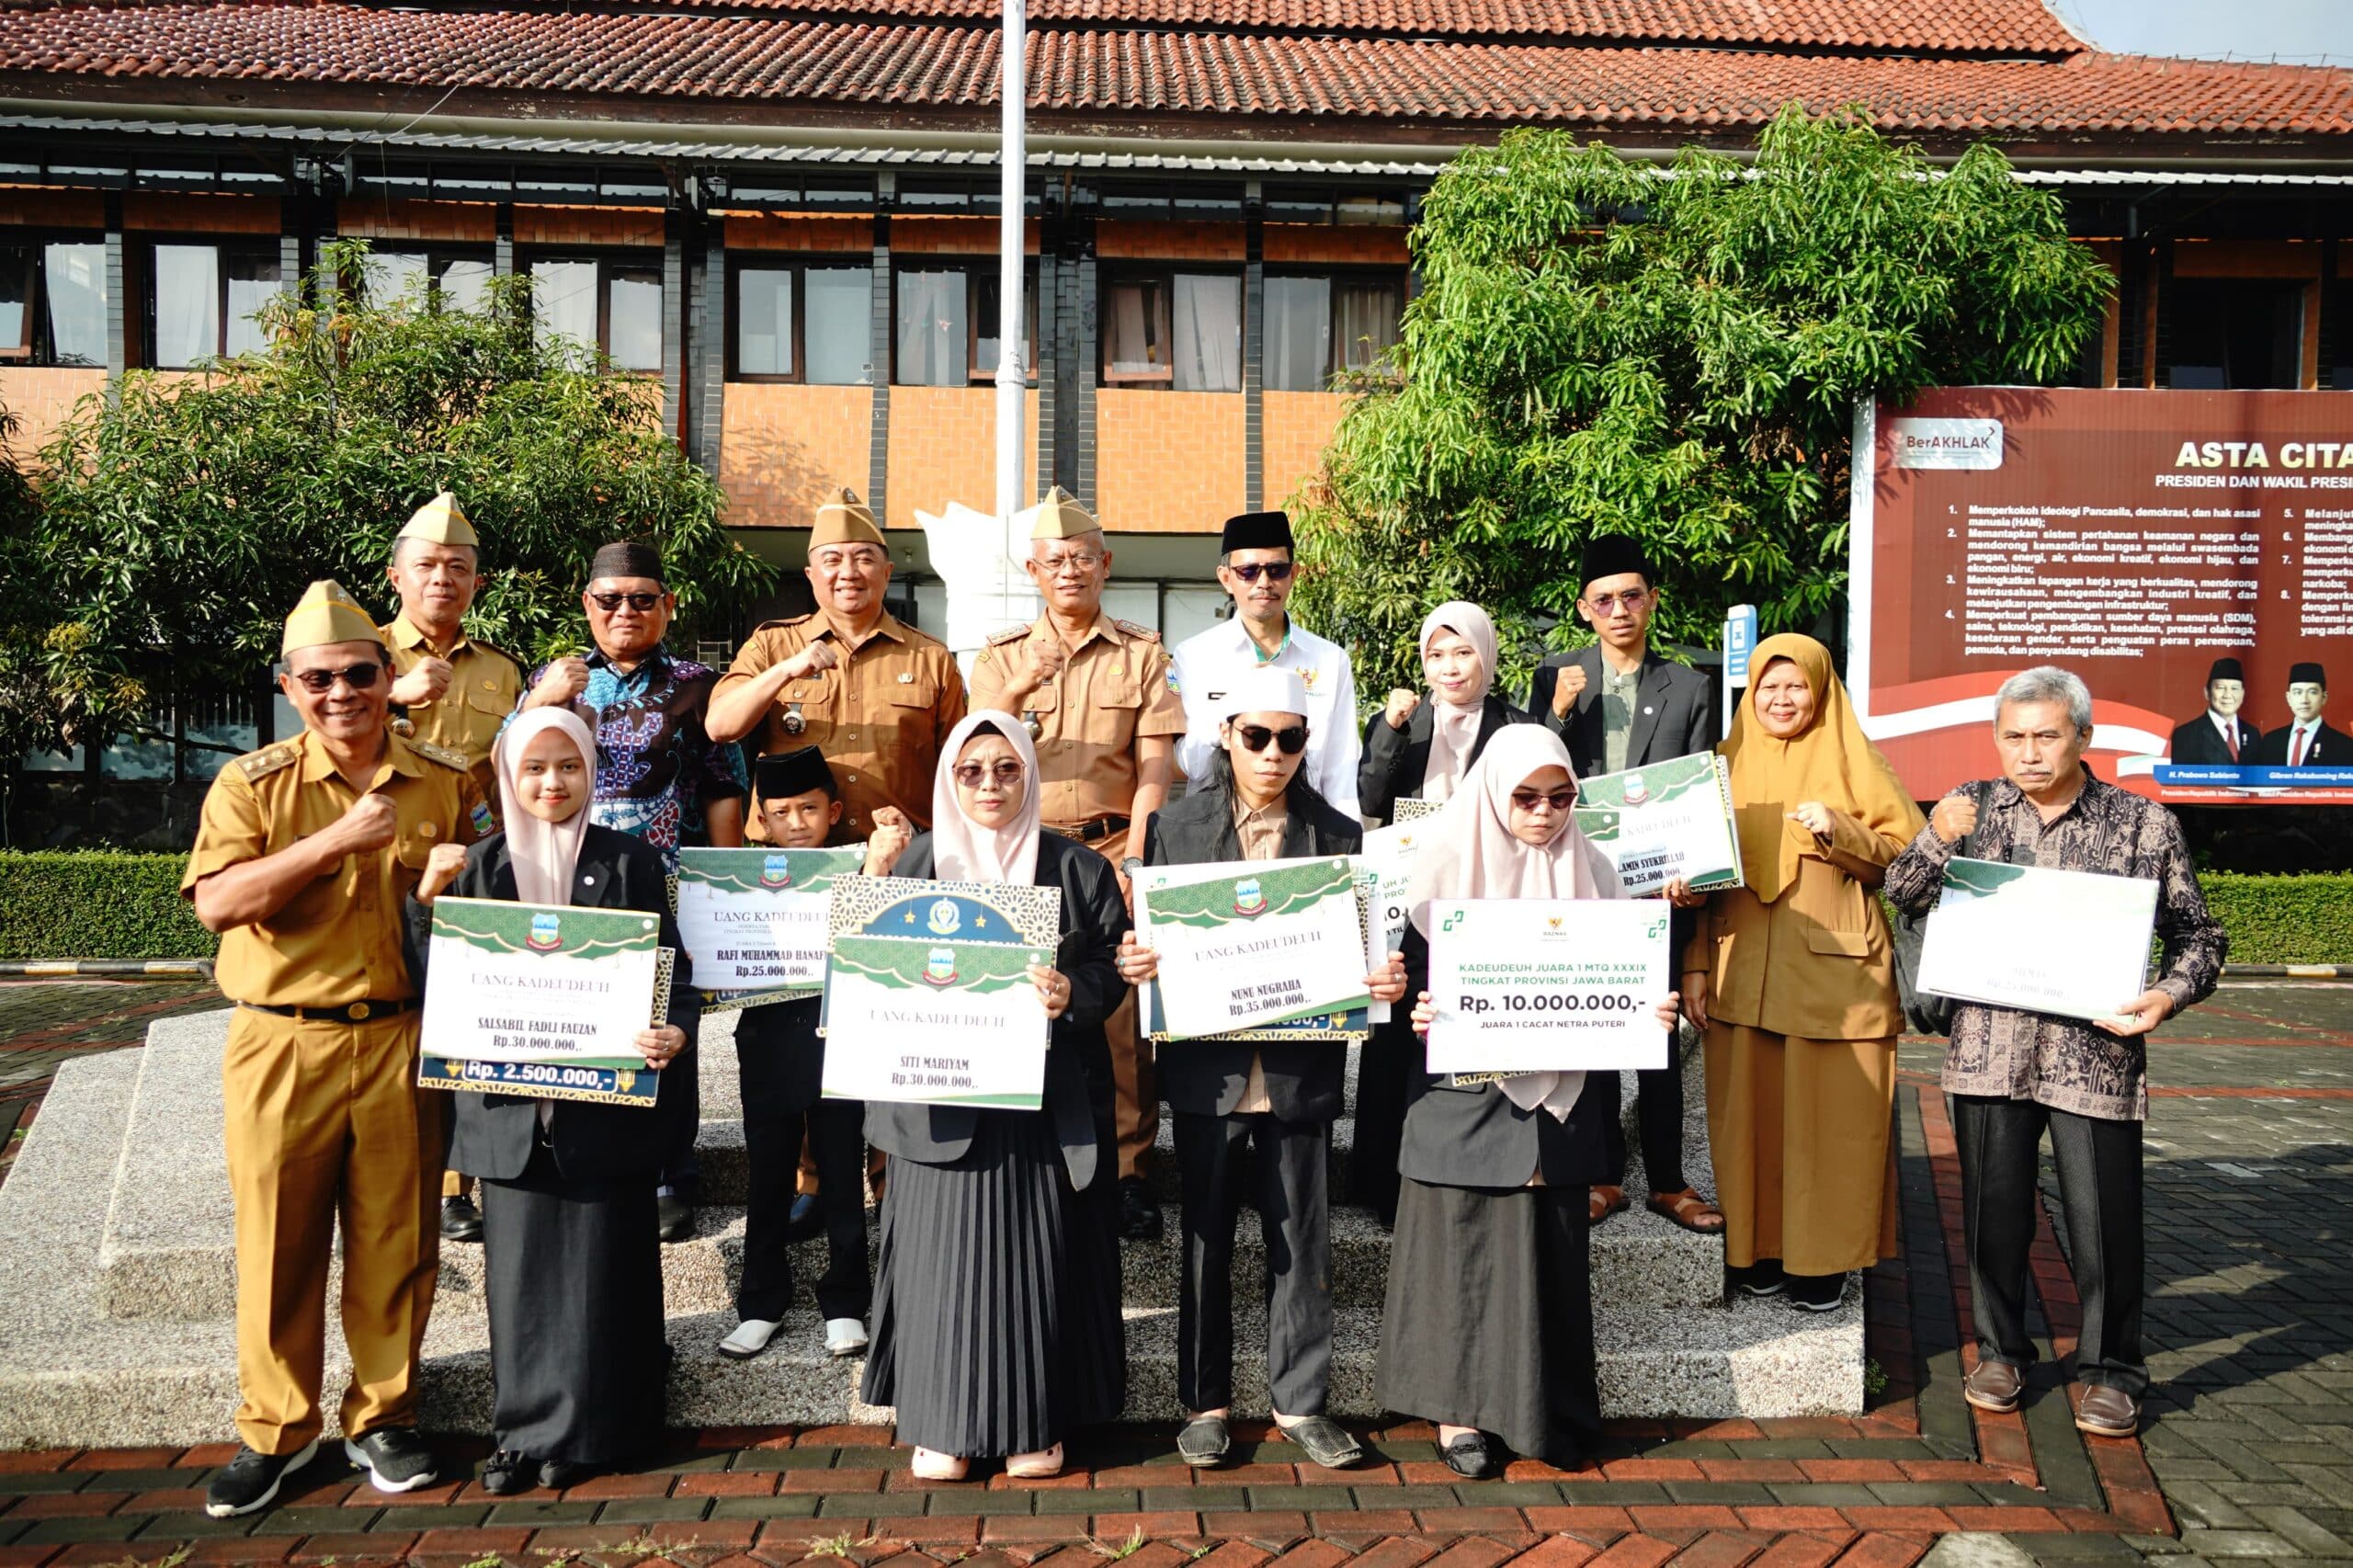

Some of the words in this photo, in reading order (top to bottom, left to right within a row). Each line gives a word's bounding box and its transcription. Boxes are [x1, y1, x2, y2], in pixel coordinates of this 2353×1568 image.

[1906, 436, 1991, 449] BerAKHLAK
[2175, 441, 2270, 469] ASTA
[2279, 442, 2353, 469] CITA
[2154, 474, 2226, 488] PRESIDEN
[2229, 476, 2259, 488] DAN
[2262, 476, 2308, 489] WAKIL
[1968, 505, 2039, 517] Memperkokoh
[2040, 506, 2081, 517] ideologi
[2083, 506, 2133, 518] Pancasila,
[2135, 507, 2190, 518] demokrasi,
[2192, 507, 2211, 517] dan
[2213, 508, 2232, 517] hak
[2234, 508, 2261, 518] asasi
[2283, 508, 2294, 518] 5.
[1968, 517, 2011, 527] manusia
[1968, 528, 2038, 540] Memantapkan
[2042, 529, 2076, 539] sistem
[2081, 530, 2139, 541] pertahanan
[2143, 531, 2195, 540] keamanan
[2200, 533, 2235, 542] negara
[2240, 532, 2260, 541] dan
[2282, 531, 2293, 541] 6.
[1967, 540, 2028, 551] mendorong
[2033, 540, 2098, 551] kemandirian
[2103, 542, 2142, 553] bangsa
[2147, 542, 2186, 552] melalui
[2190, 544, 2259, 553] swasembada
[2303, 544, 2347, 553] ekonomi
[1967, 553, 2007, 563] pangan,
[2072, 554, 2115, 563] ekonomi
[2158, 554, 2202, 564] ekonomi
[2239, 555, 2259, 565] dan
[2281, 555, 2292, 564] 7.
[1967, 563, 2010, 574] ekonomi
[1966, 574, 2036, 586] Meningkatkan
[2038, 576, 2084, 587] lapangan
[2086, 576, 2111, 587] kerja
[2113, 577, 2138, 587] yang
[2200, 578, 2258, 590] mendorong
[2053, 588, 2143, 599] mengembangkan
[2148, 589, 2189, 598] industri
[2237, 590, 2257, 600] dan
[2280, 589, 2291, 599] 8.
[1966, 598, 2026, 609] melanjutkan
[2028, 599, 2103, 610] pengembangan
[2301, 603, 2339, 613] dengan
[1965, 609, 2028, 620] Memperkuat
[2031, 611, 2102, 622] pembangunan
[2106, 611, 2144, 621] sumber
[2147, 612, 2172, 623] daya
[2176, 613, 2219, 622] manusia
[2166, 624, 2207, 634] prestasi
[2300, 626, 2326, 637] yang
[1965, 633, 2021, 643] kesetaraan
[2070, 634, 2097, 644] serta
[2100, 636, 2155, 646] penguatan
[2160, 637, 2190, 646] peran
[2008, 645, 2028, 654] dan
[2028, 646, 2089, 657] penyandang
[714, 911, 751, 923] UANG
[717, 949, 738, 961] RAFI
[741, 949, 792, 961] MUHAMMAD
[1459, 963, 1532, 972] KADEUDEUH
[1536, 963, 1574, 972] JUARA
[1577, 963, 1582, 971] 1
[1585, 963, 1609, 973] MTQ
[1613, 963, 1647, 972] XXXIX
[1461, 976, 1511, 985] TINGKAT
[1514, 976, 1568, 985] PROVINSI
[1572, 976, 1604, 985] JAWA
[1608, 976, 1646, 985] BARAT
[1231, 987, 1255, 1001] NUNU
[1256, 979, 1302, 997] NUGRAHA
[1460, 995, 1495, 1014] Rp.
[1502, 994, 1646, 1013] 10.000.000,-
[477, 1017, 525, 1032] SALSABIL
[528, 1019, 558, 1034] FADLI
[561, 1021, 597, 1036] FAUZAN
[1591, 1020, 1626, 1028] PUTERI
[900, 1055, 920, 1068] SITI
[923, 1057, 970, 1072] MARIYAM
[467, 1060, 499, 1081] Rp.
[503, 1062, 613, 1091] 2.500.000,-
